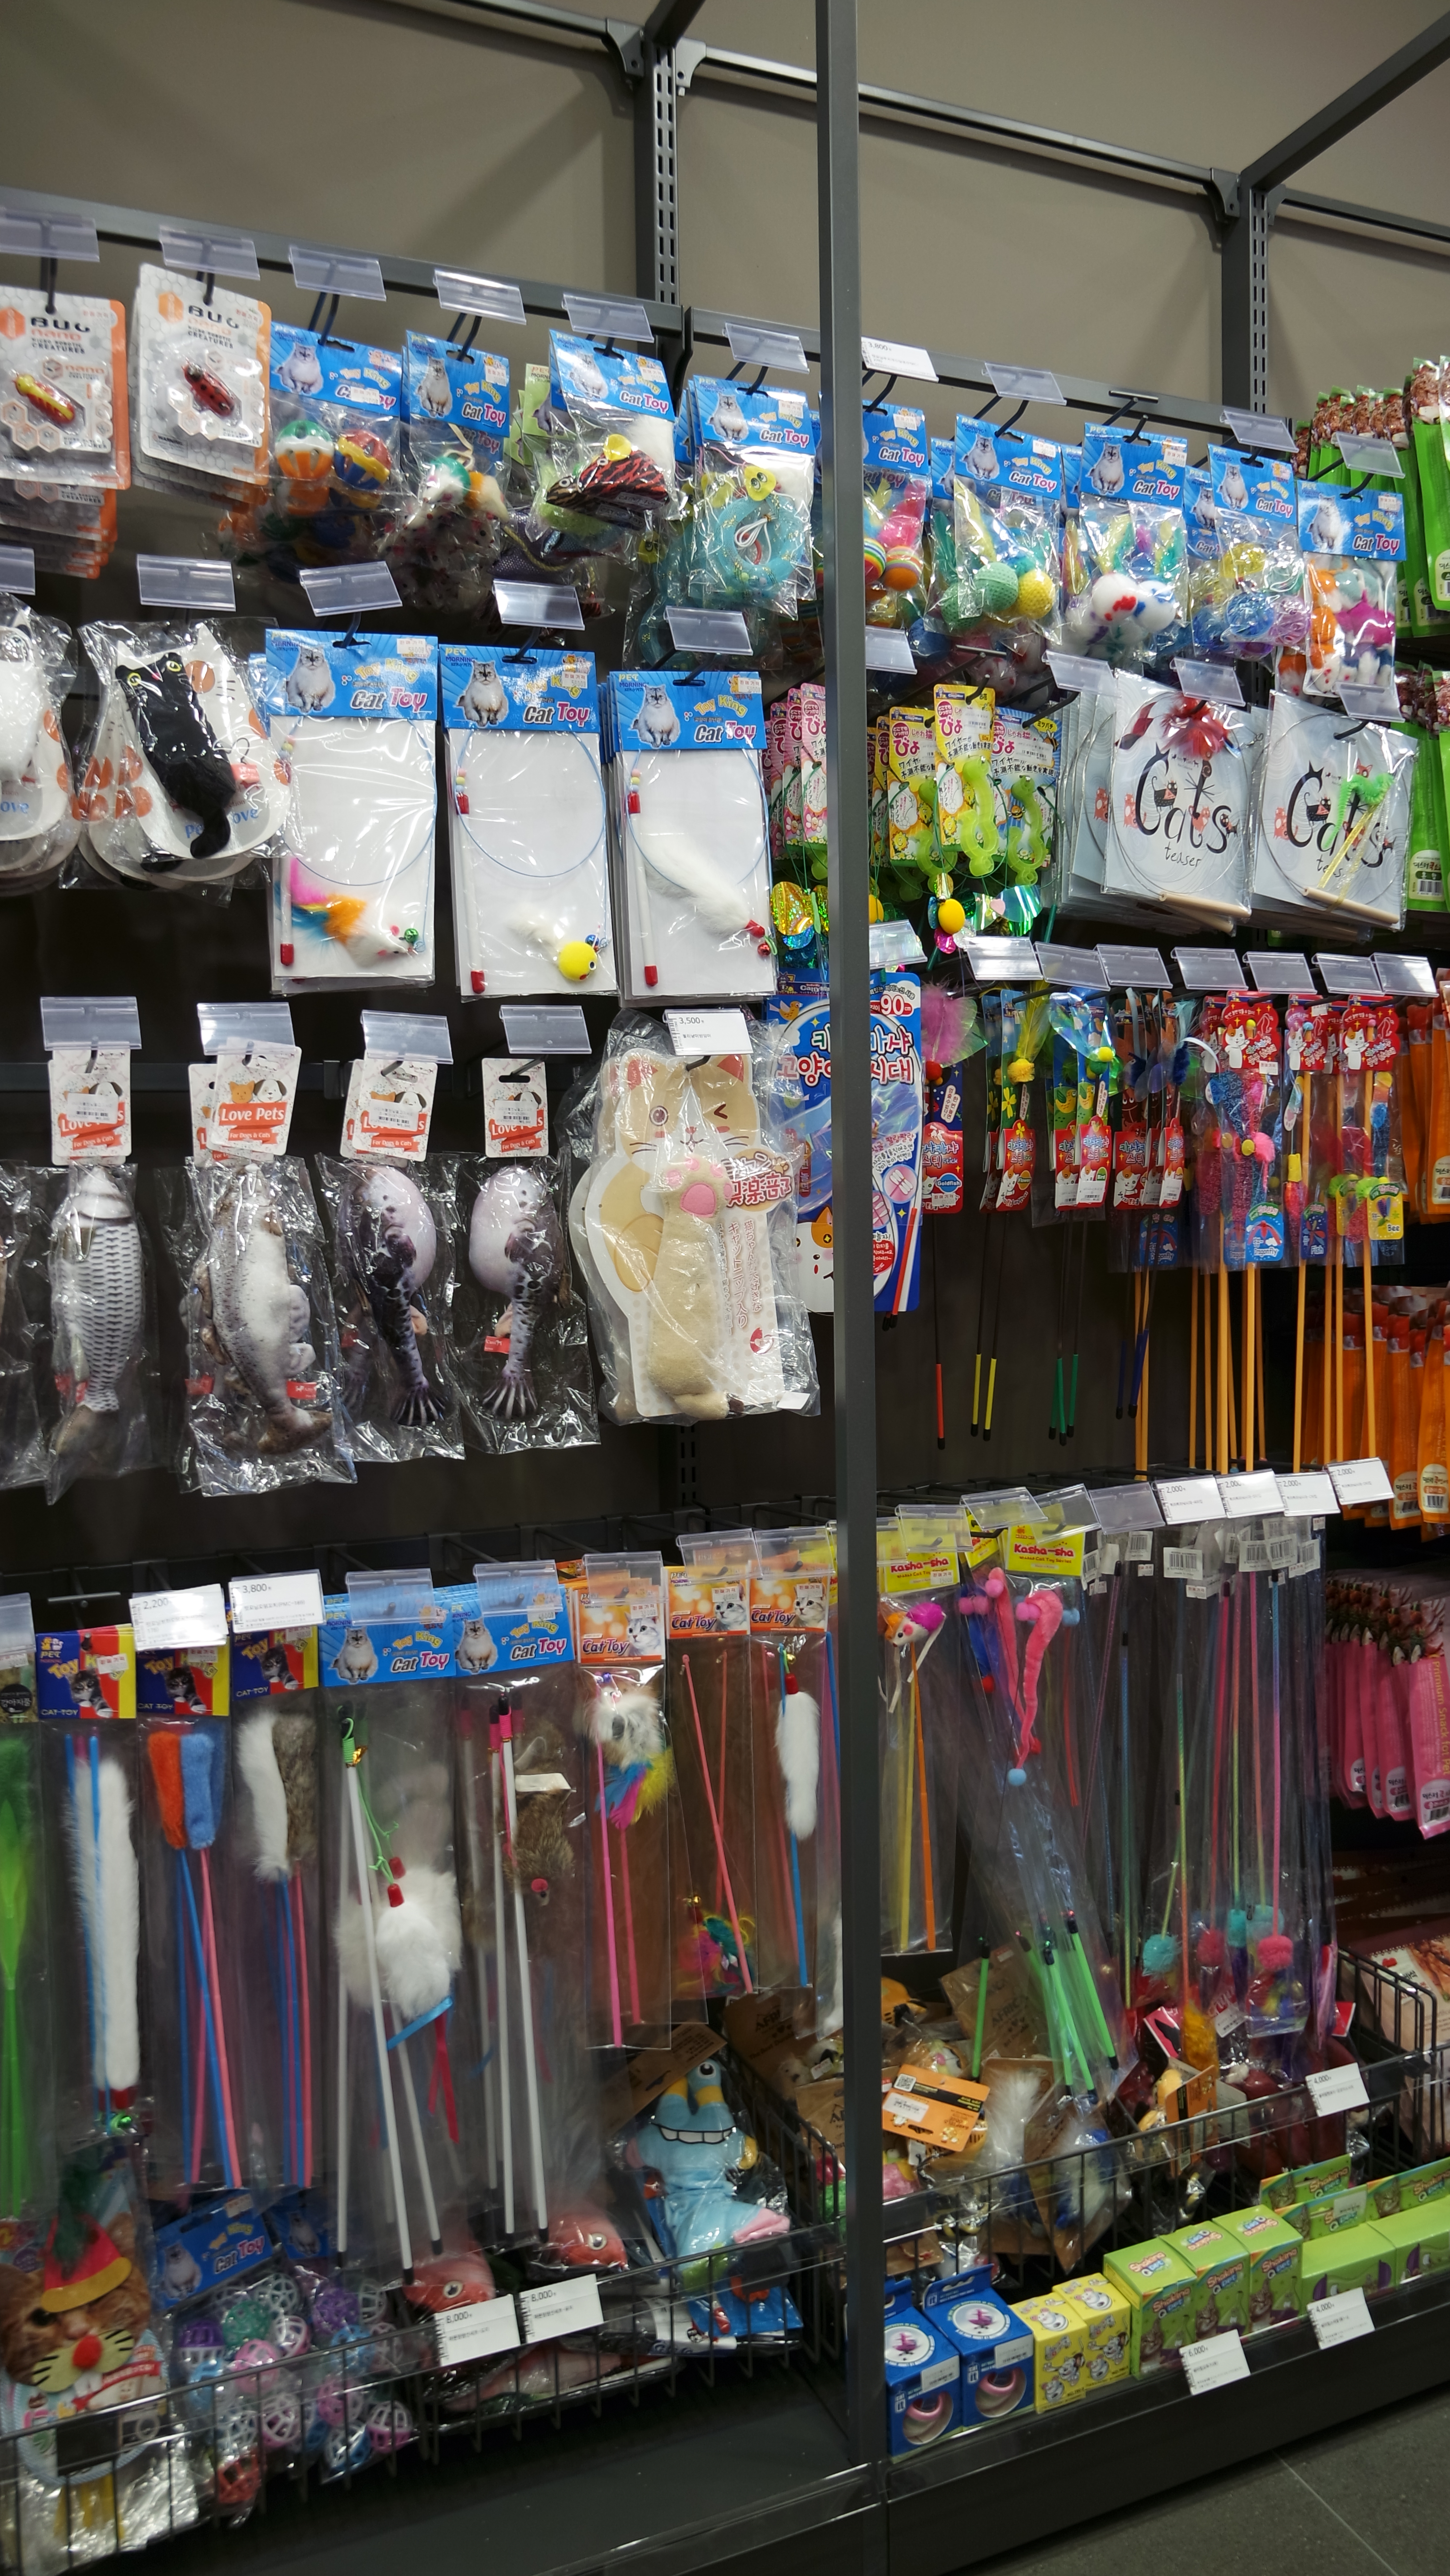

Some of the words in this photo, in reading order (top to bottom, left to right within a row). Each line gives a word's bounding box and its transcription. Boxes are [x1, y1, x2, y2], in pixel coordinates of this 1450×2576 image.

[32, 343, 85, 354] CREATURES
[188, 331, 234, 349] CREATURES
[619, 390, 643, 408] Cat
[643, 392, 669, 415] Toy
[462, 402, 483, 421] Cat
[483, 403, 507, 428] Toy
[760, 428, 783, 443] Cat
[783, 427, 810, 448] Toy
[896, 427, 918, 446] King
[878, 447, 901, 462] Cat
[901, 447, 925, 468] Toy
[1030, 456, 1052, 475] King
[1009, 471, 1032, 486] Cat
[1032, 473, 1058, 493] Toy
[1133, 479, 1155, 496] Cat
[1156, 479, 1180, 501] Toy
[1256, 498, 1275, 512] Cat
[1273, 499, 1294, 519] Toy
[1352, 534, 1373, 552] Cat
[1375, 533, 1401, 556] Toy
[445, 648, 467, 656] PET
[355, 662, 381, 679] Toy
[385, 658, 420, 683] King
[350, 690, 386, 709] Cat
[390, 687, 427, 713] Toy
[695, 699, 716, 715] Toy
[718, 695, 747, 717] King
[523, 706, 555, 724] Cat
[557, 701, 589, 727] Toy
[694, 725, 723, 742] Cat
[725, 721, 756, 744] Toy
[1037, 722, 1054, 730] ミツバチ
[1135, 748, 1232, 854] Cats
[1165, 842, 1202, 867] teaser
[880, 995, 905, 1015] 90
[221, 1108, 252, 1121] Love
[256, 1107, 284, 1120] Pets
[886, 1132, 915, 1145] 팔랑팔랑
[887, 1143, 913, 1156] 움직여주면
[1010, 1152, 1024, 1166] 스틱
[886, 1158, 897, 1167] 눈이
[937, 1179, 960, 1187] Goldfish
[1254, 1248, 1278, 1256] Dragonfly
[1311, 1245, 1324, 1254] Fish
[728, 1222, 749, 1329] キャットニップ入り
[671, 1616, 694, 1629] Cat
[751, 1611, 773, 1624] Cat
[511, 1622, 531, 1638] Toy
[532, 1620, 559, 1633] King
[242, 1638, 269, 1660] Toy
[393, 1636, 413, 1650] Toy
[416, 1631, 443, 1647] King
[511, 1644, 536, 1661] Cat
[538, 1638, 567, 1657] Toy
[582, 1640, 605, 1654] Cat
[48, 1659, 79, 1679] Toy
[144, 1656, 174, 1674] Toy
[391, 1659, 418, 1673] Cat
[419, 1651, 450, 1669] Toy
[1432, 1661, 1445, 1704] Primium
[1438, 1707, 1449, 1738] Snack
[1442, 1758, 1450, 1775] Pet
[1309, 2166, 1349, 2193] Shaking
[214, 2250, 238, 2274] Cat
[238, 2235, 265, 2258] Toy
[1128, 2251, 1167, 2272] Shaking
[1261, 2246, 1298, 2273] Shaking
[1206, 2262, 1244, 2288] Shaking
[1152, 2287, 1192, 2312] Shaking
